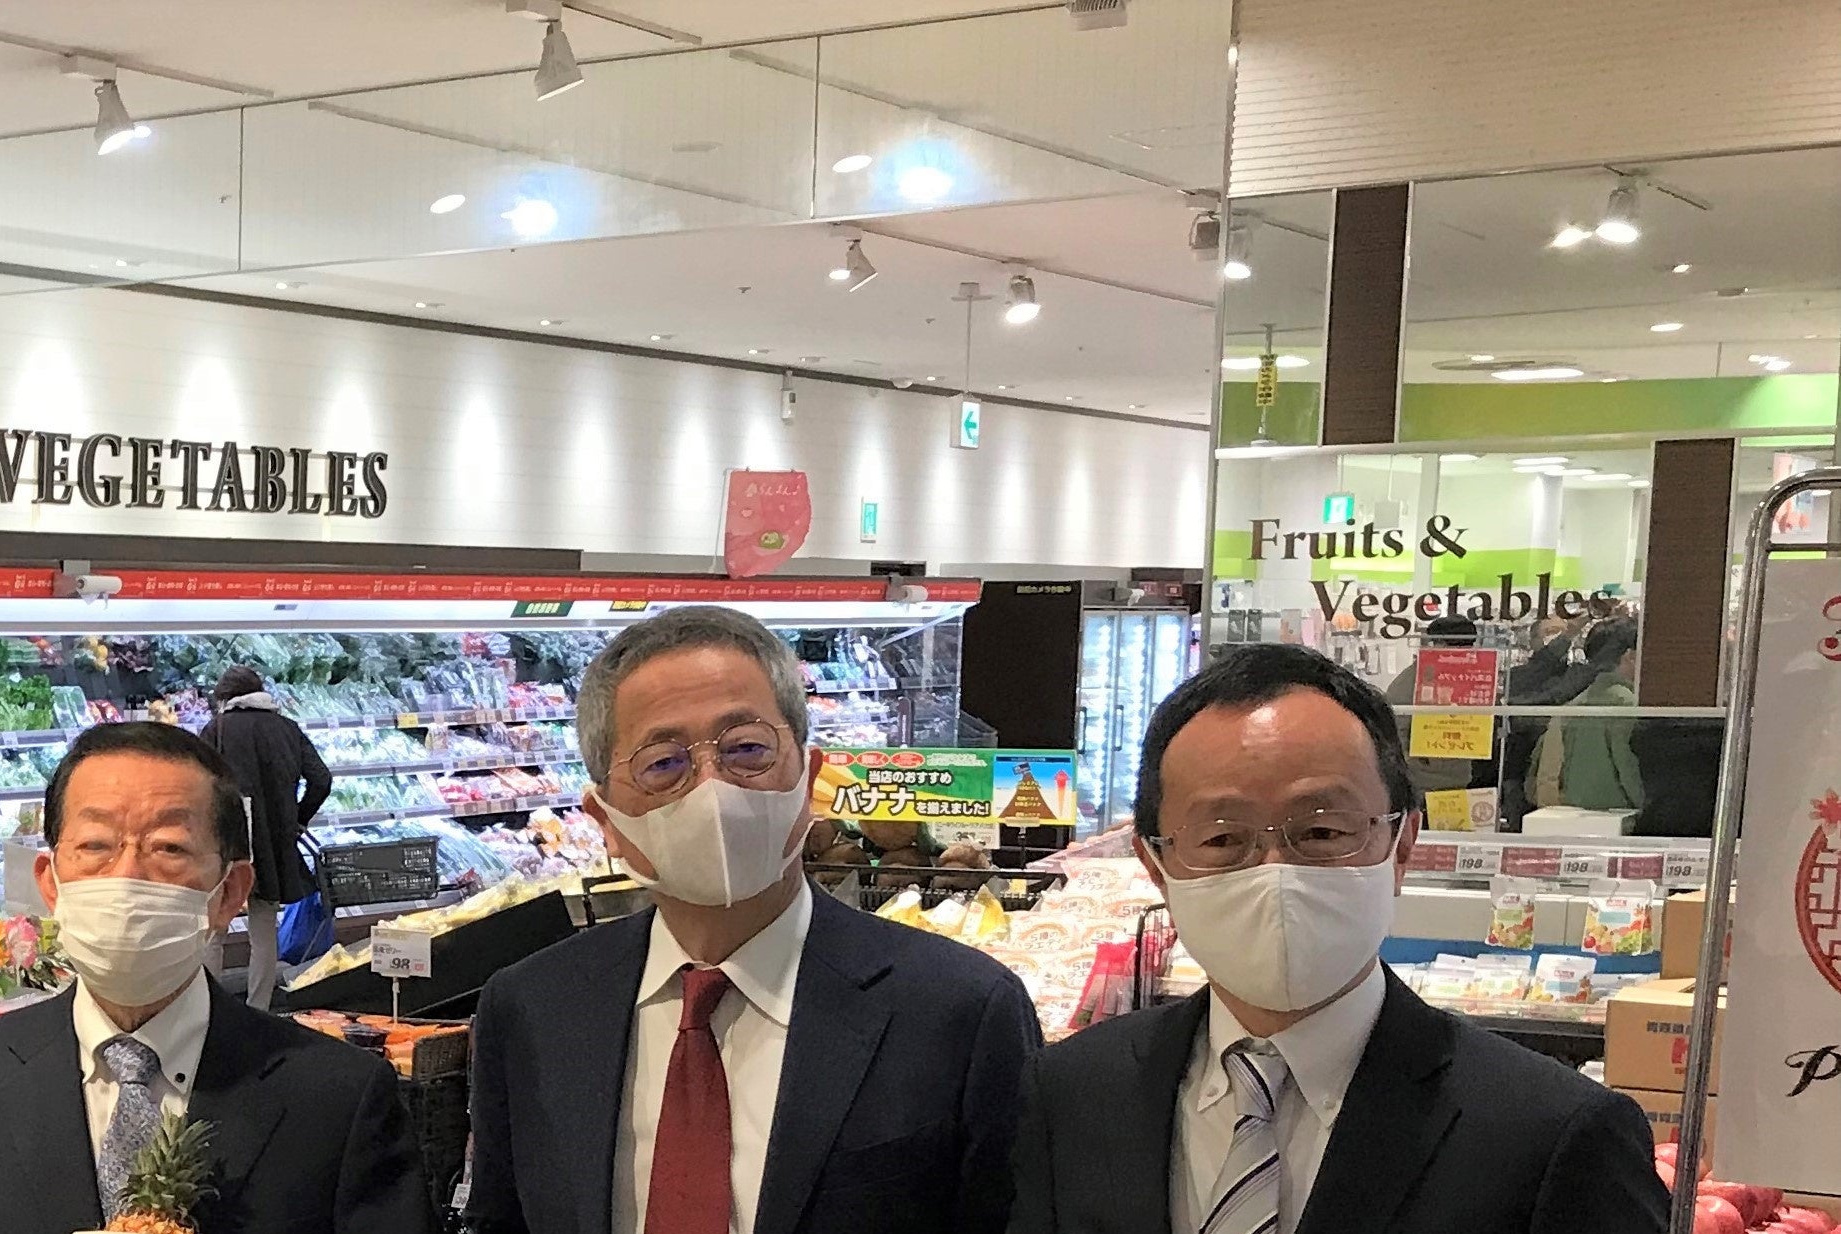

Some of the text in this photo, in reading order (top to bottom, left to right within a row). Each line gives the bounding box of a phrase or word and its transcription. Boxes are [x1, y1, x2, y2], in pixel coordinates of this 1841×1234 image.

[1246, 514, 1469, 561] Fruits &
[1309, 571, 1616, 640] Vegetables
[868, 770, 953, 785] 当店のおすすめ
[831, 785, 917, 816] バナナ
[1565, 860, 1589, 874] 198
[1667, 865, 1692, 877] 198
